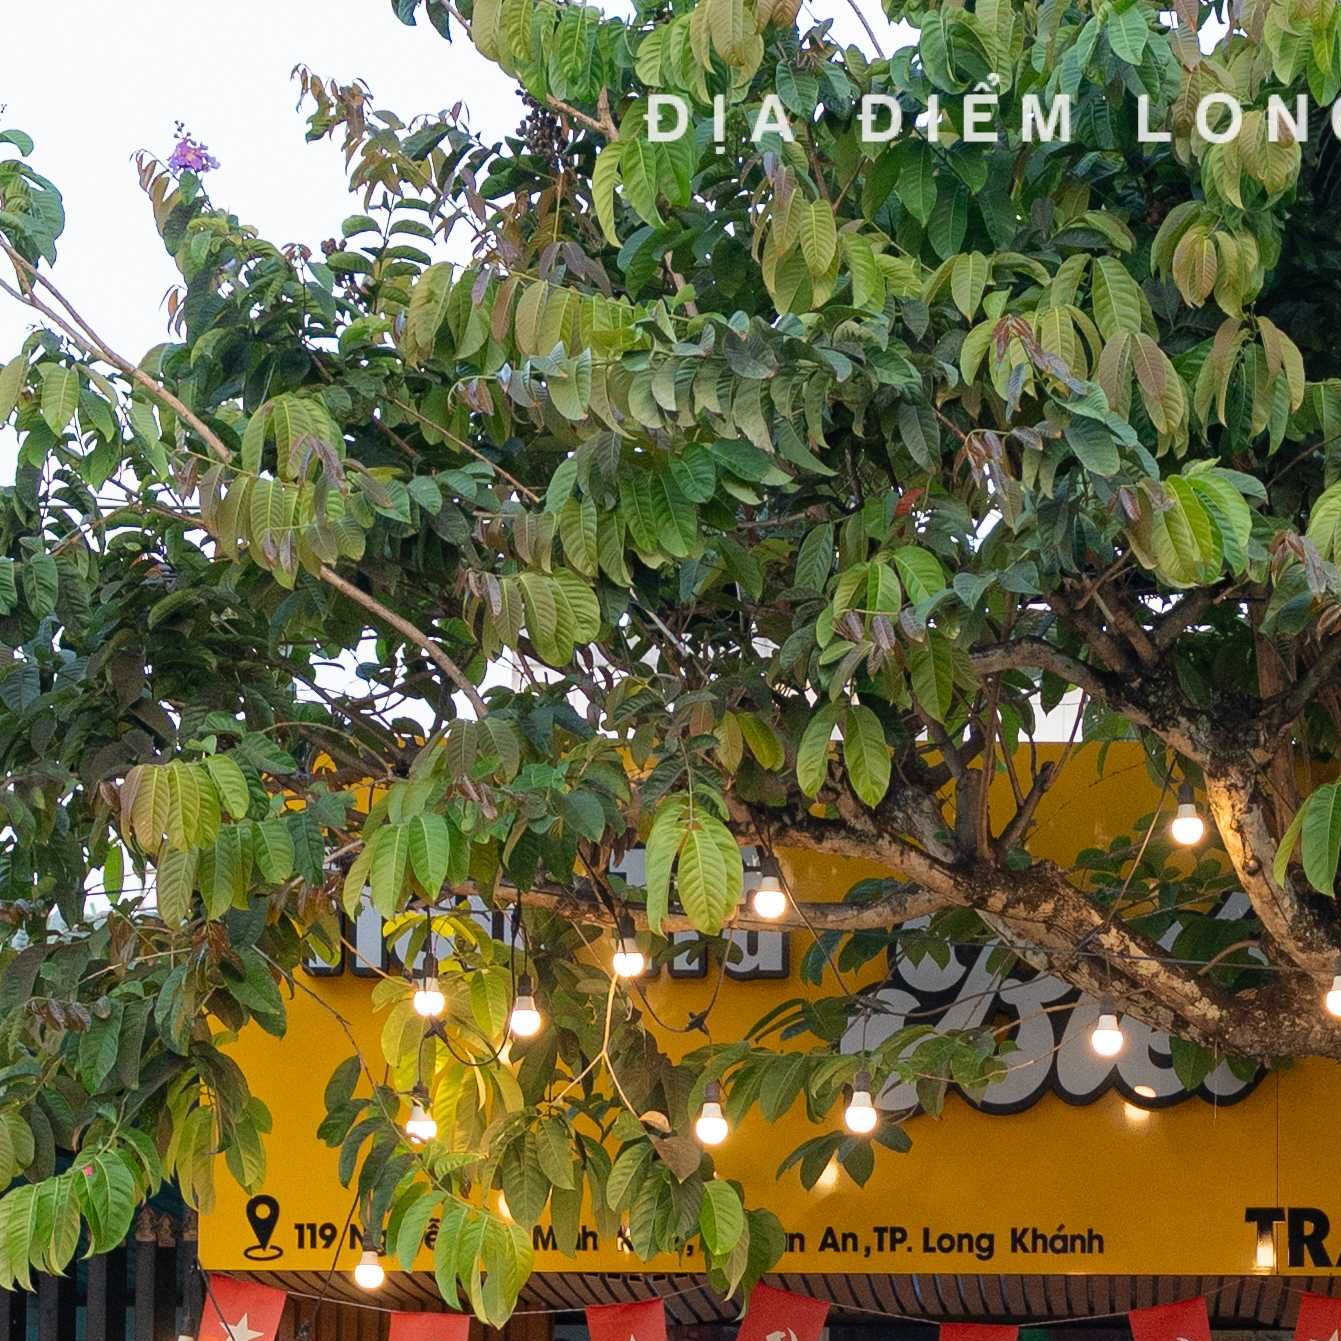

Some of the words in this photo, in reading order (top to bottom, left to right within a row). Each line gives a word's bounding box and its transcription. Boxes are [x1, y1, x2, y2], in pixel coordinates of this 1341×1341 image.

[294, 1222, 337, 1250] 119
[922, 1227, 995, 1261] Long
[1010, 1223, 1104, 1254] Khánh
